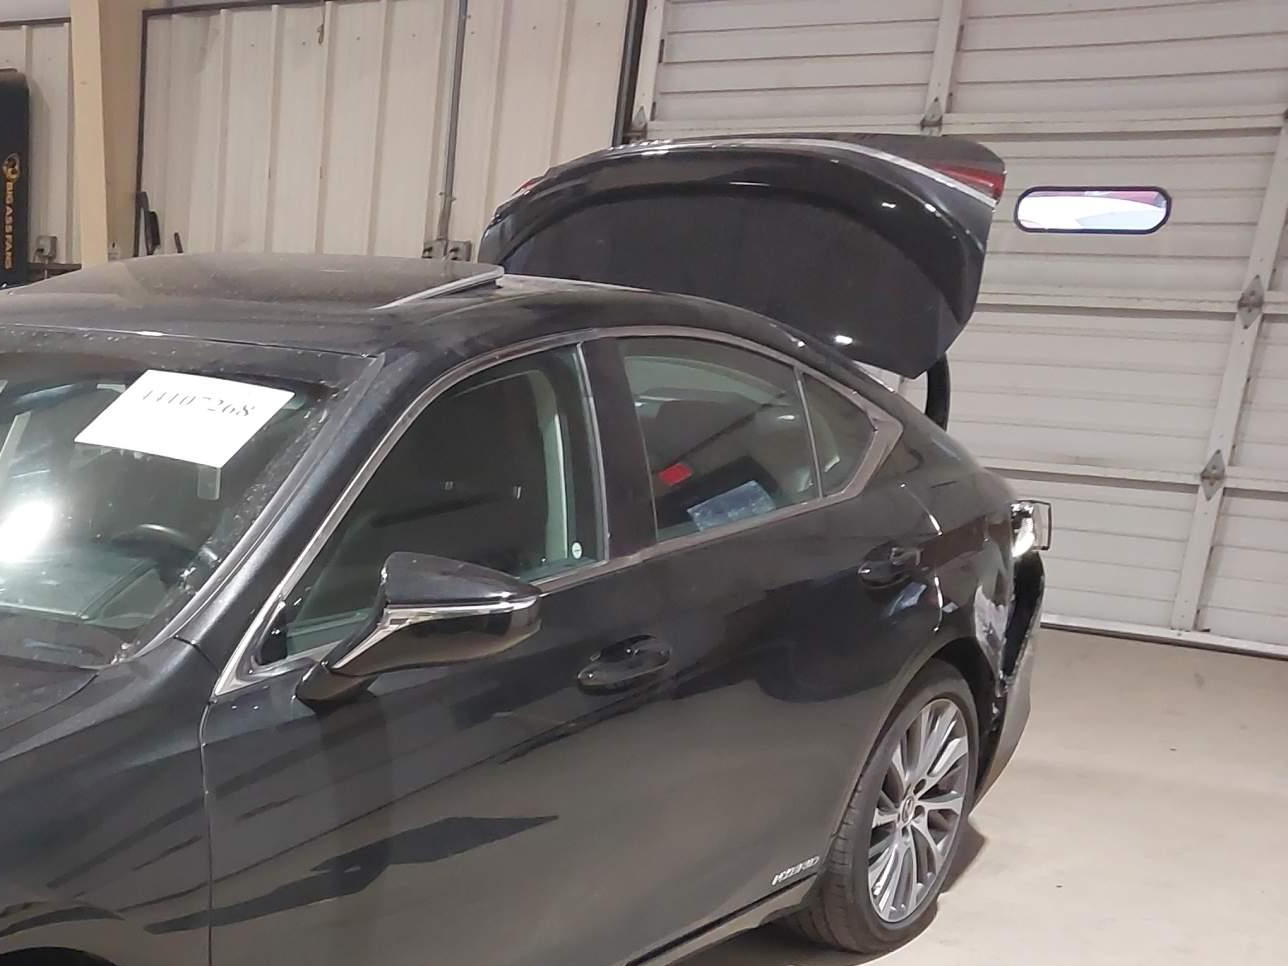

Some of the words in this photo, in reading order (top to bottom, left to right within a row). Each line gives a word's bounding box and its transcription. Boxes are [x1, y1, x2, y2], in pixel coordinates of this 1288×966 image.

[5, 181, 14, 205] BIG
[5, 205, 13, 233] ASS
[4, 234, 13, 270] FANS
